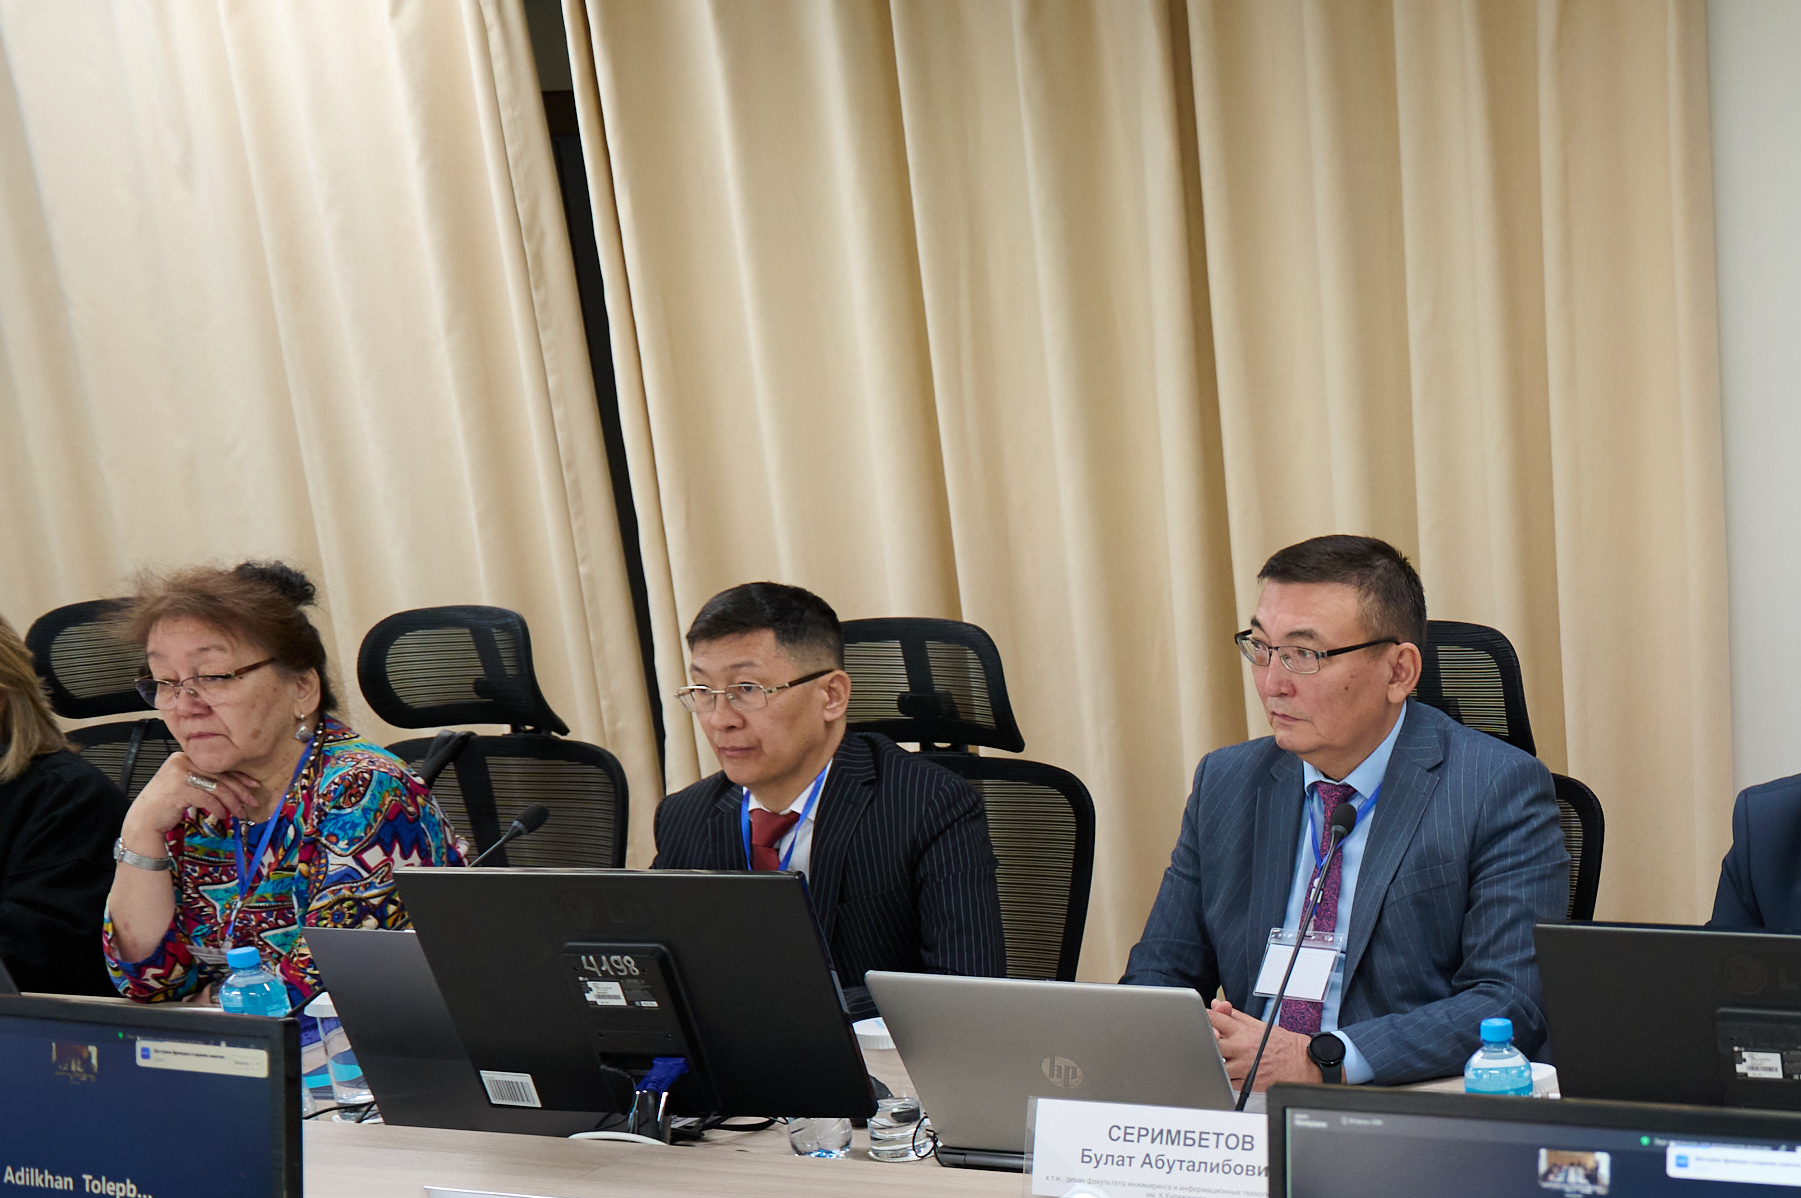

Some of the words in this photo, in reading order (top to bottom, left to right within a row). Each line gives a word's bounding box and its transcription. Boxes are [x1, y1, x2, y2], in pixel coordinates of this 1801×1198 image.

[581, 955, 640, 976] 4198
[1049, 1055, 1078, 1088] hp
[1108, 1124, 1255, 1152] СЕРИМБЕТОВ
[1080, 1148, 1136, 1169] Булат
[1140, 1152, 1269, 1178] Абуталибови
[3, 1165, 74, 1191] Adilkhan
